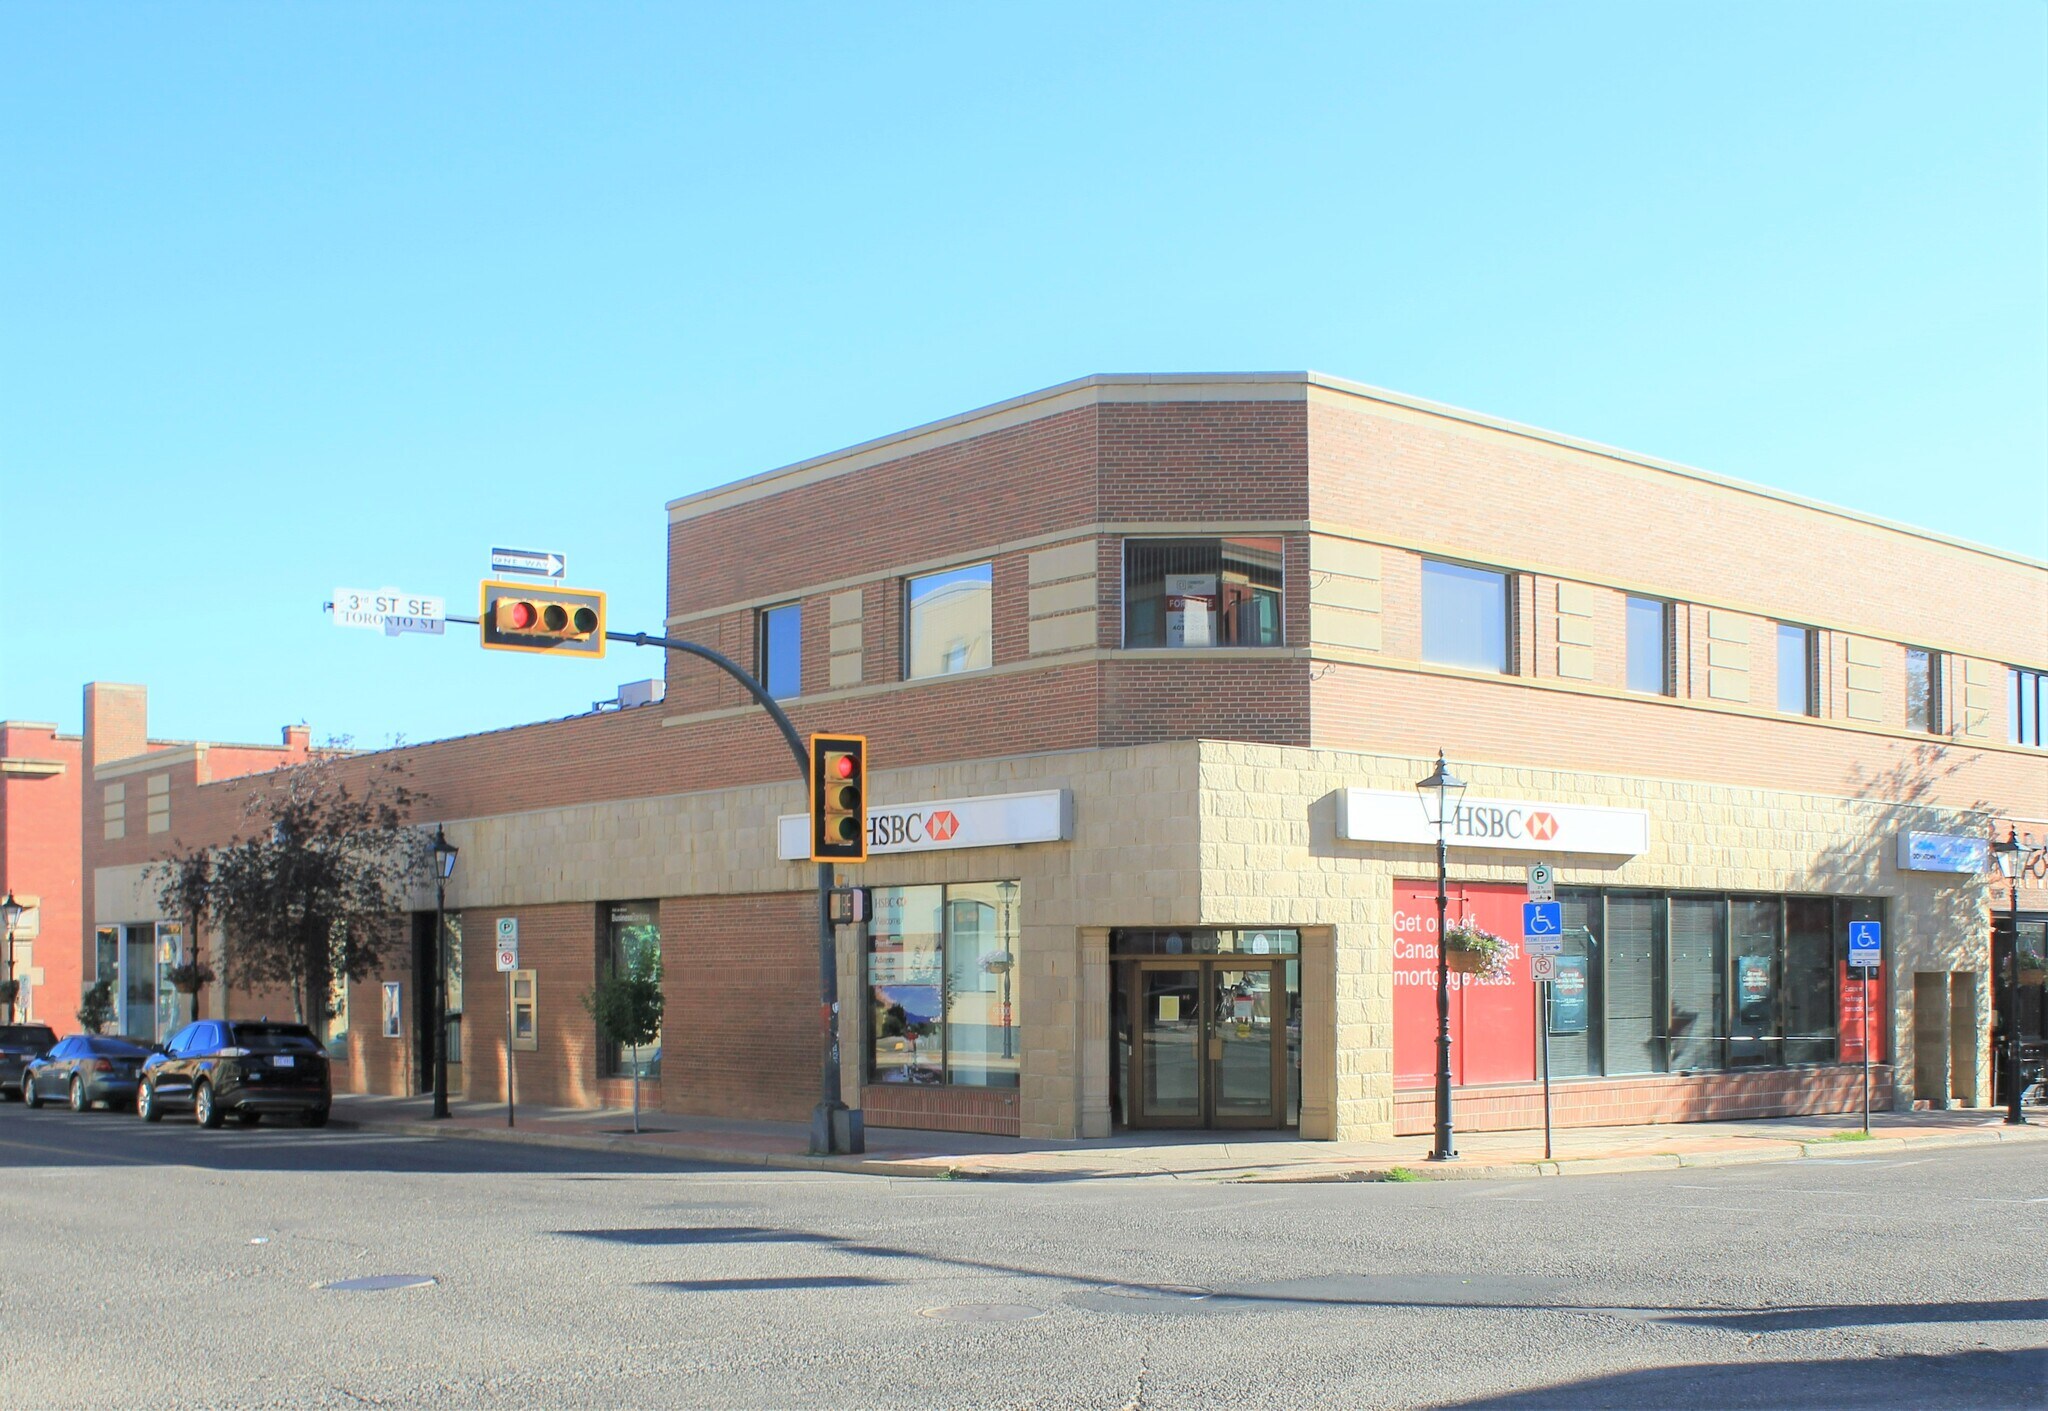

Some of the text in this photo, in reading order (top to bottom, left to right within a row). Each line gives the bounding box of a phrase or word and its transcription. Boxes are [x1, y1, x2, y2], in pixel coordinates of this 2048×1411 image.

[494, 556, 549, 569] ONE WAY
[376, 596, 400, 613] ST
[408, 600, 433, 616] SE
[343, 610, 437, 630] TORONTO ST
[867, 812, 922, 846] HSBC
[1454, 805, 1522, 839] HSBC
[1536, 870, 1545, 881] P
[1393, 910, 1422, 933] Get
[1425, 916, 1455, 933] oe
[1191, 936, 1220, 950] 602
